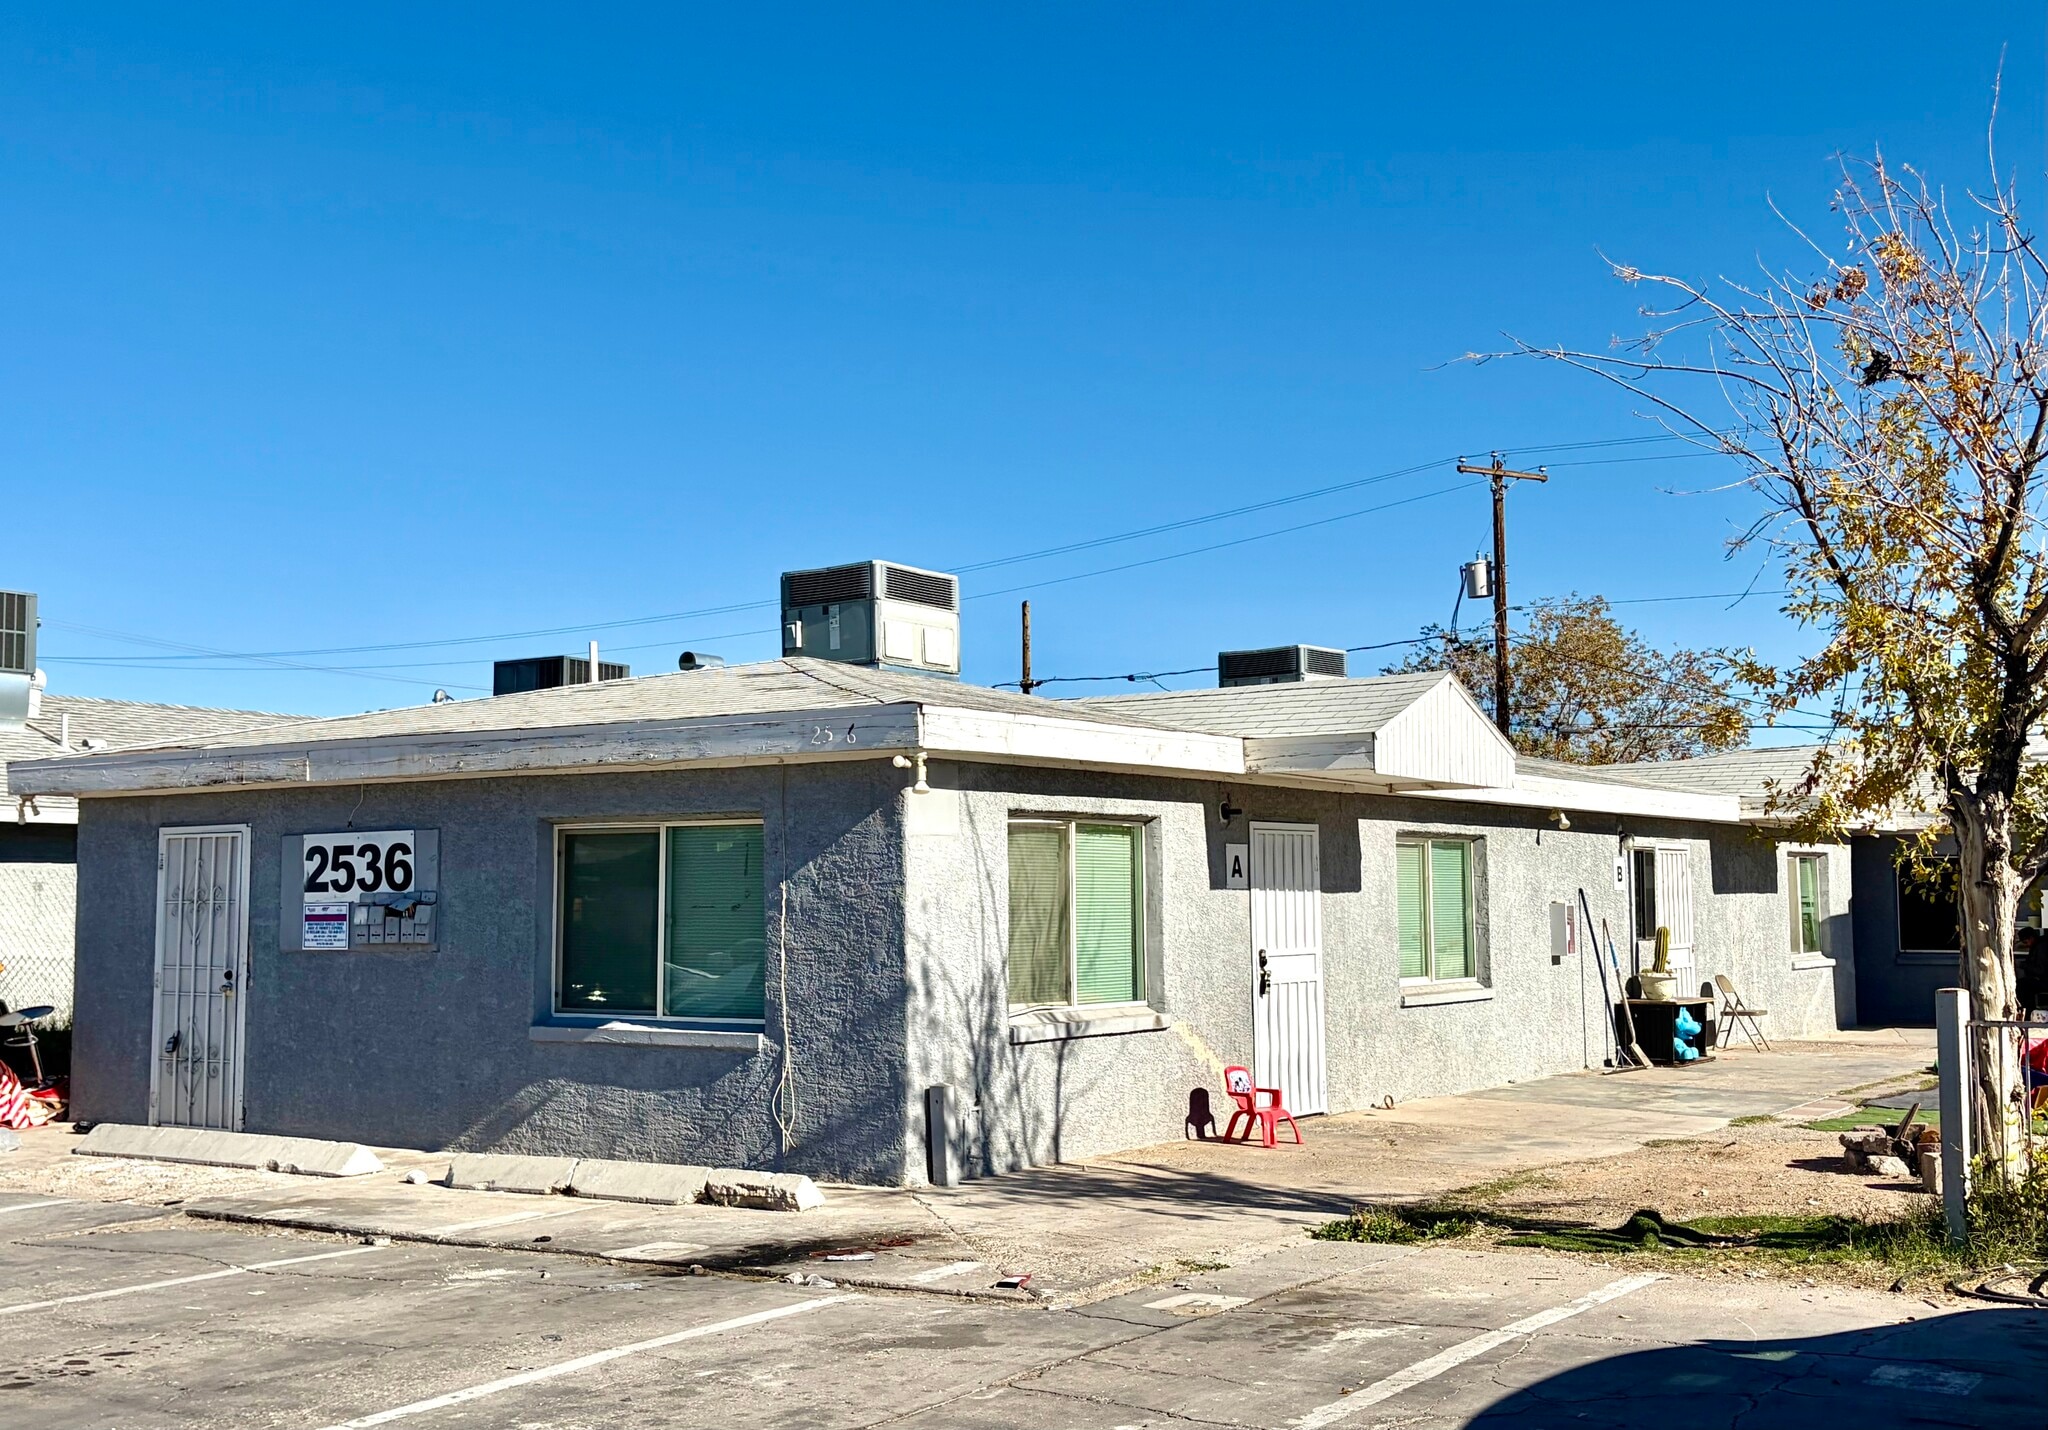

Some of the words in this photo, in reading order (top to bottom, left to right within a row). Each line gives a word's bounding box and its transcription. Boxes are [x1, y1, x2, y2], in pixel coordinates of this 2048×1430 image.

[304, 843, 413, 893] 2536
[1231, 854, 1243, 878] A
[1617, 866, 1623, 882] B
